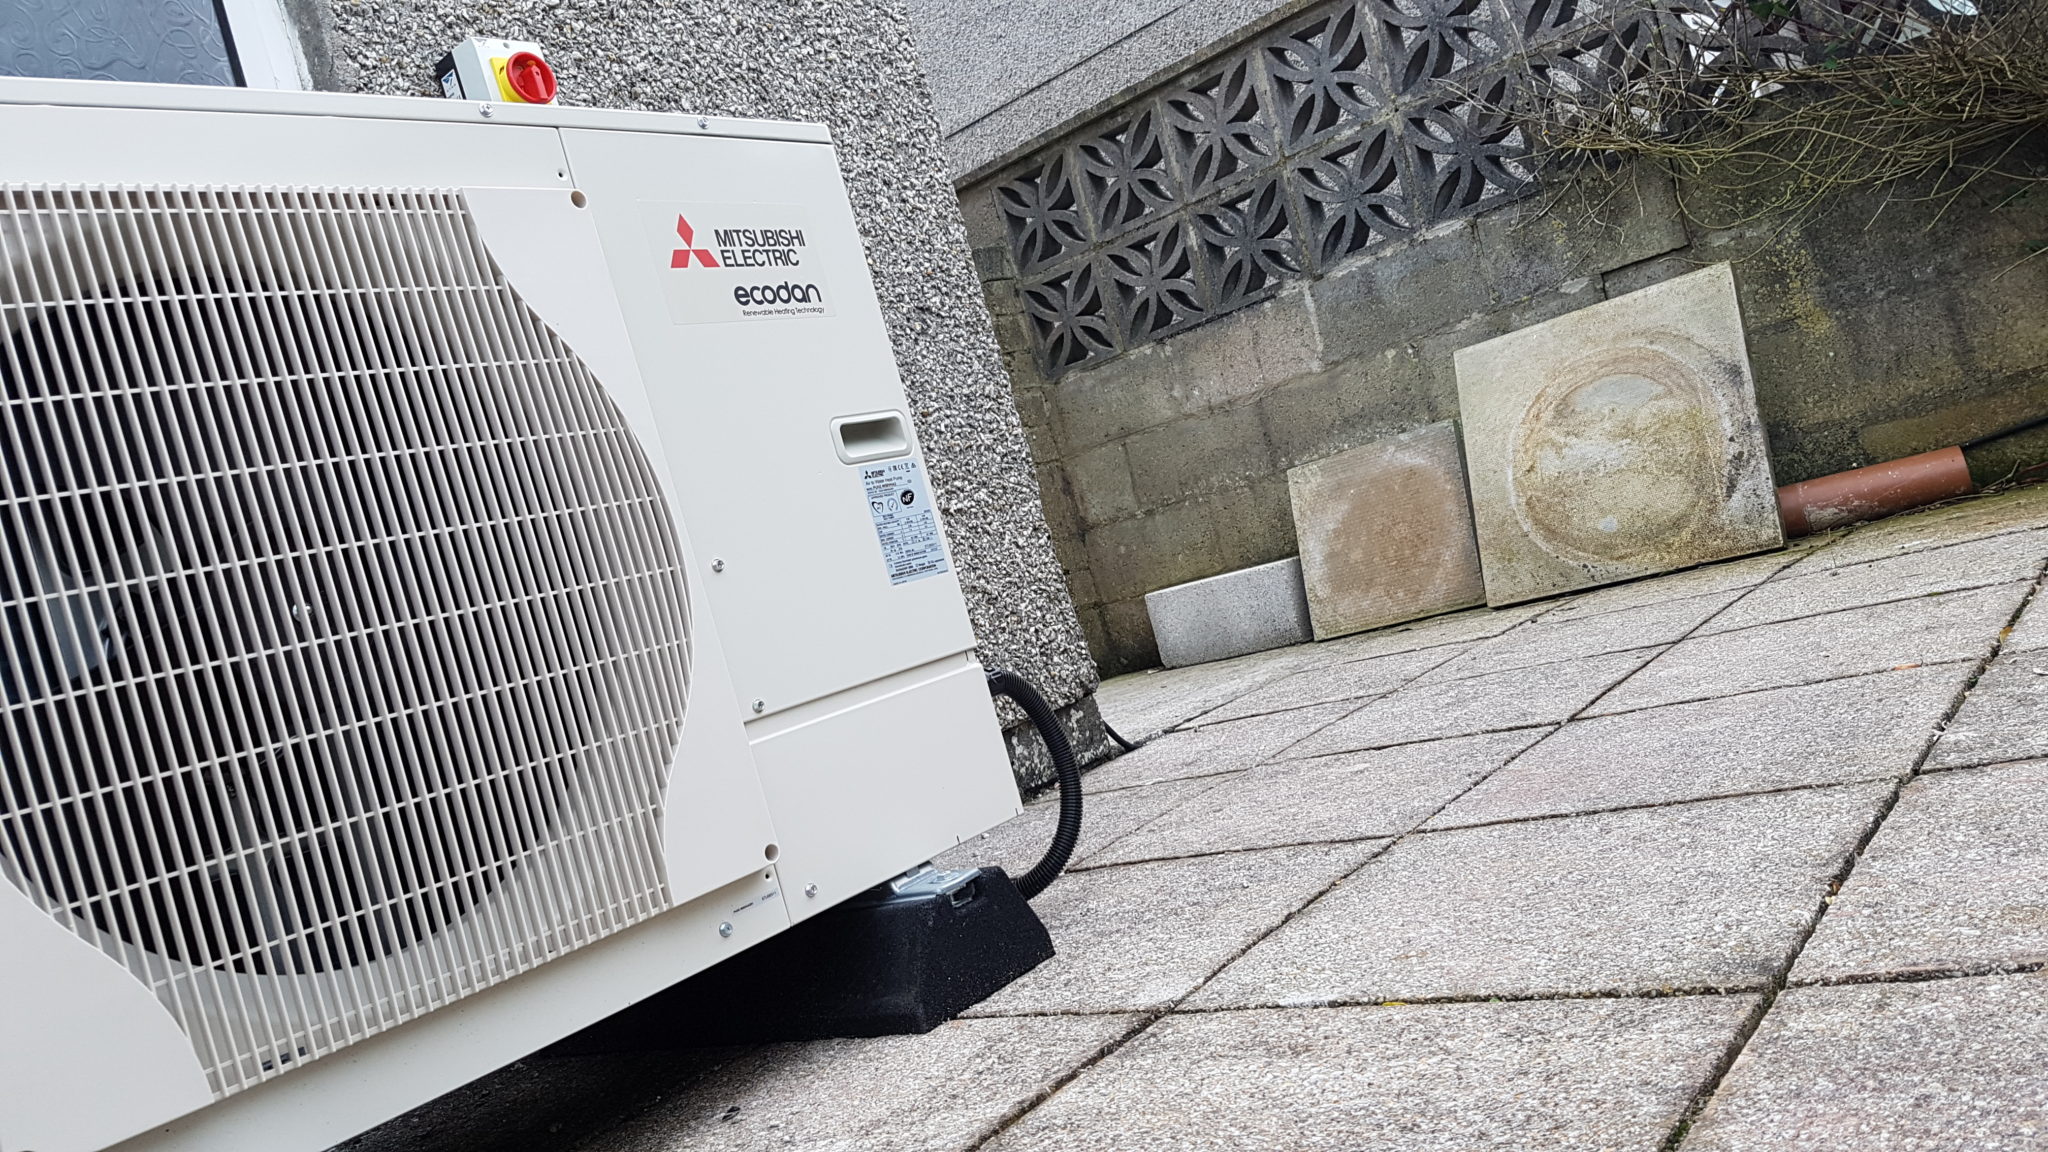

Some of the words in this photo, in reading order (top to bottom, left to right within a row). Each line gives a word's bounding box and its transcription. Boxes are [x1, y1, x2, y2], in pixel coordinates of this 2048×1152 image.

[714, 229, 806, 247] MITSUBISHI
[720, 249, 800, 267] ELECTRIC
[734, 281, 822, 306] ecodan
[742, 309, 774, 317] Renewable
[774, 308, 796, 316] Heating
[795, 306, 825, 314] Technology
[901, 492, 913, 503] NF
